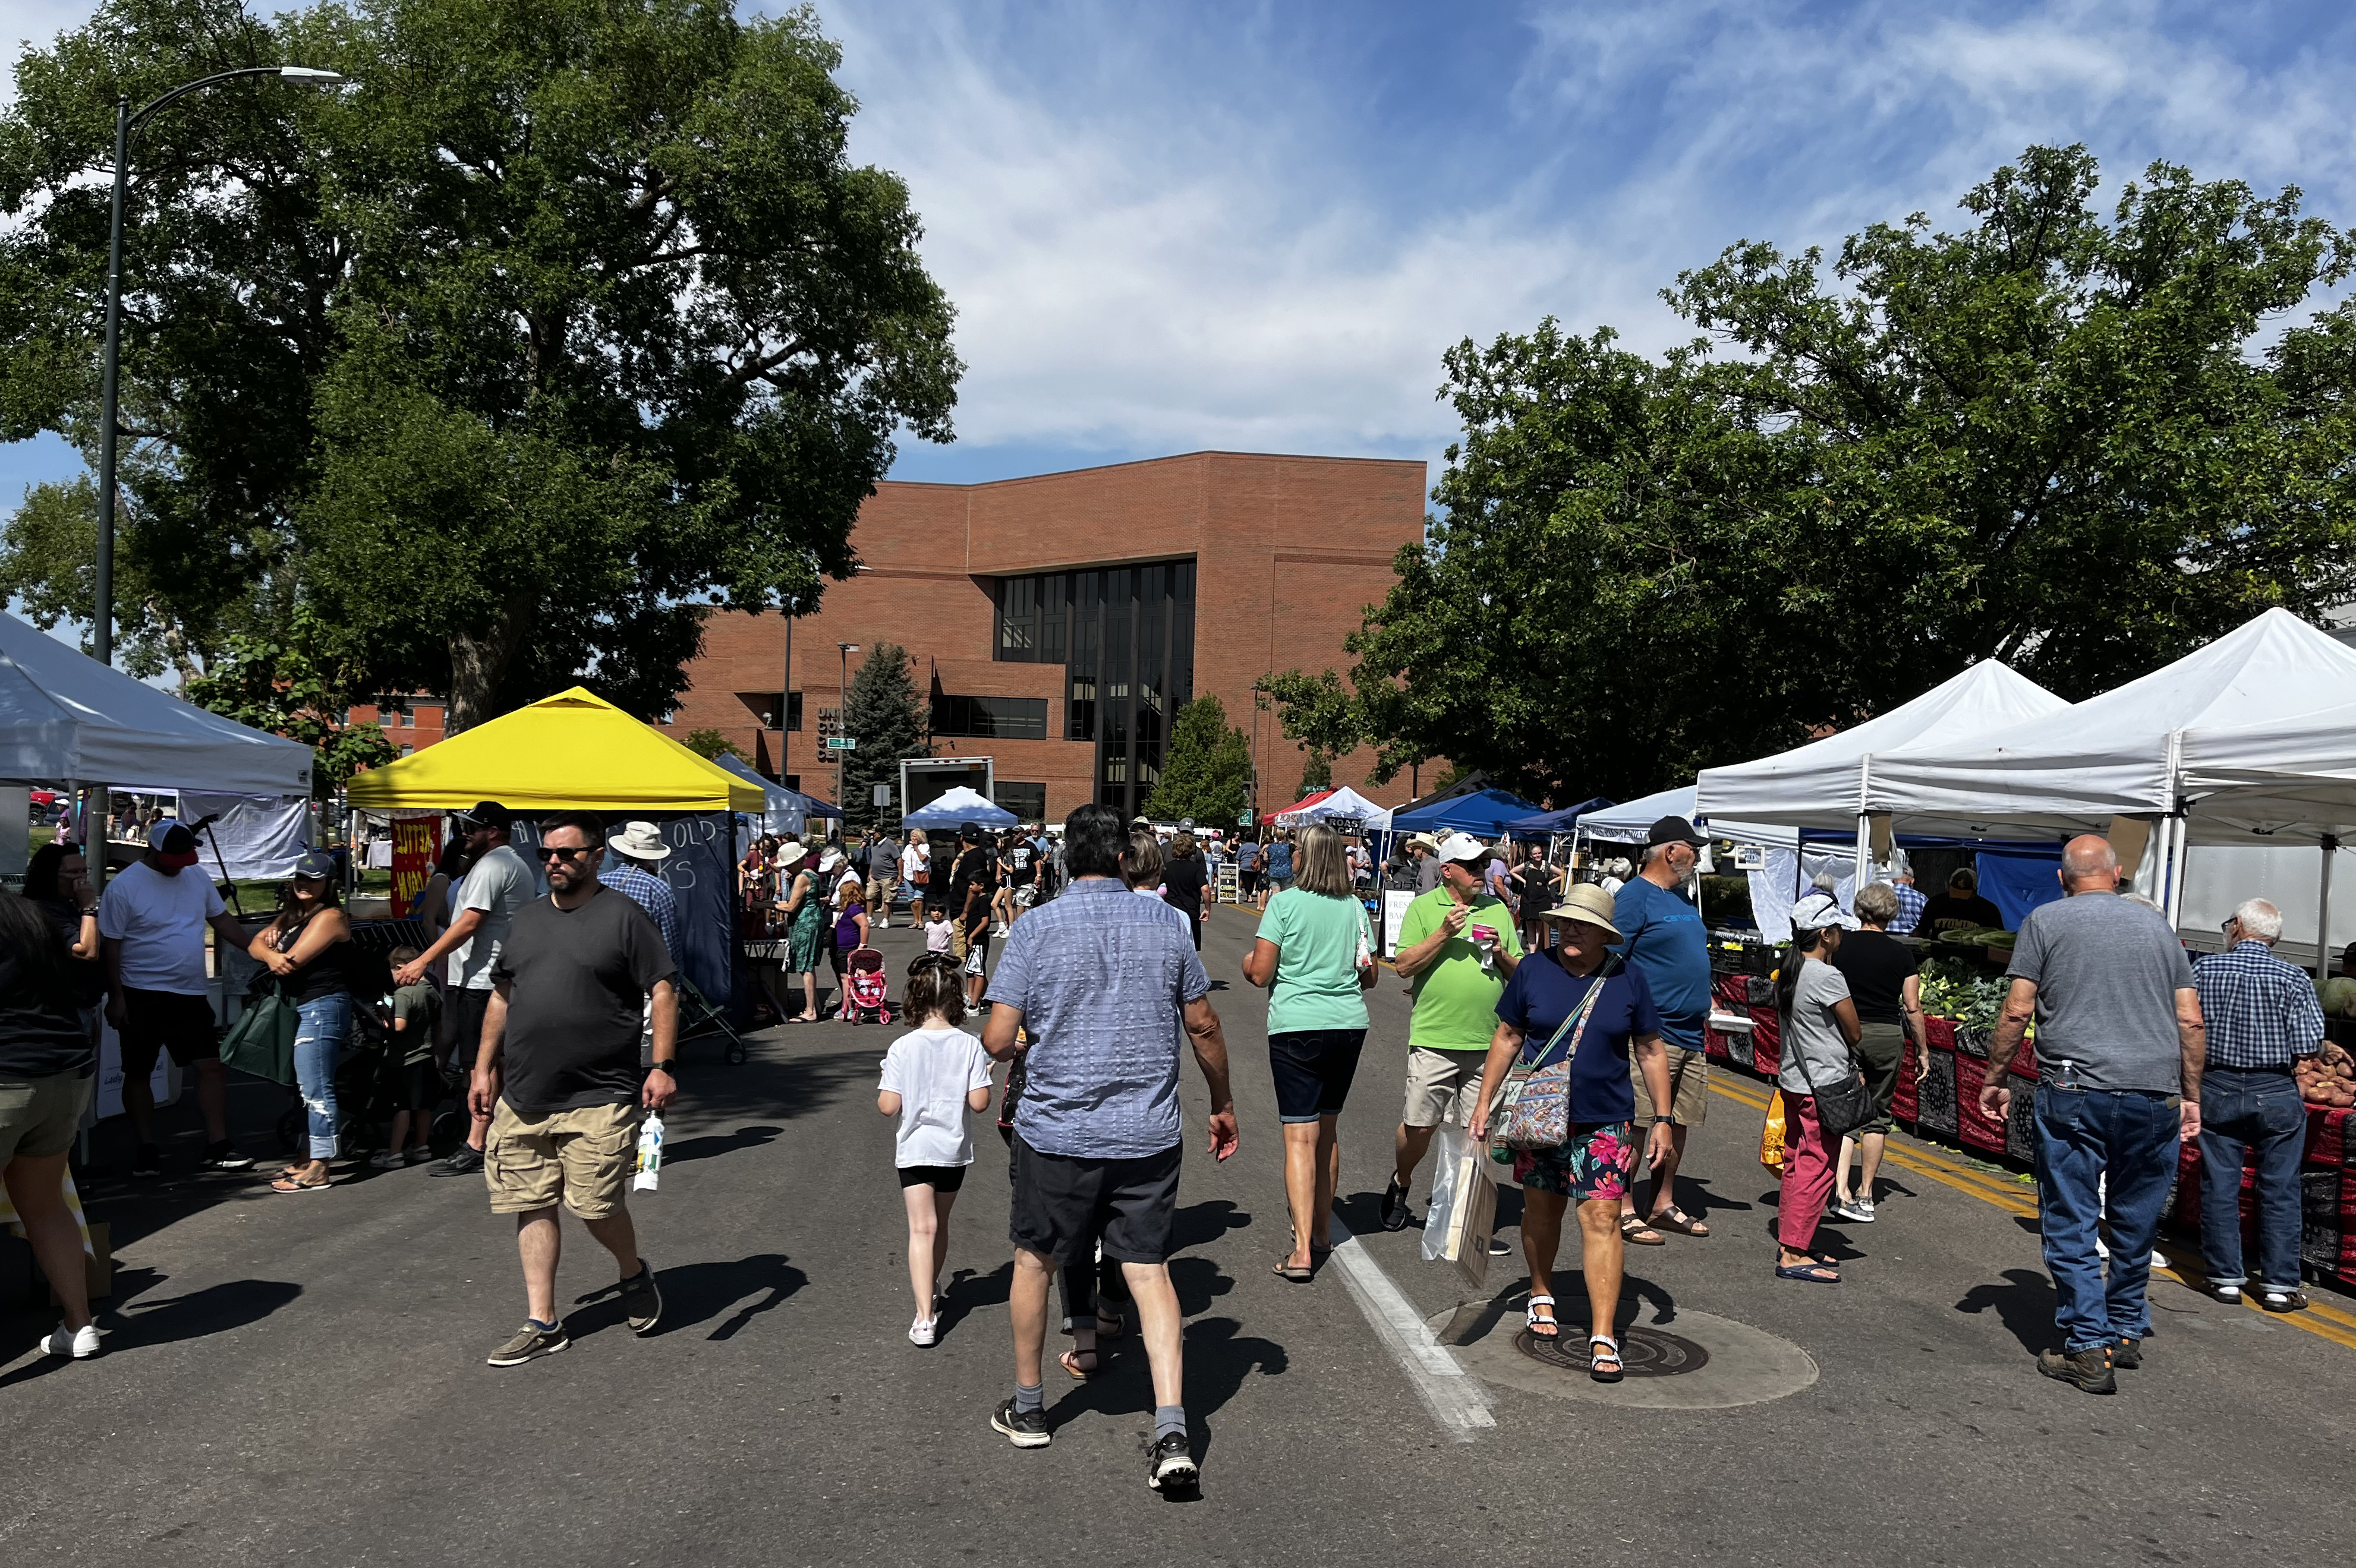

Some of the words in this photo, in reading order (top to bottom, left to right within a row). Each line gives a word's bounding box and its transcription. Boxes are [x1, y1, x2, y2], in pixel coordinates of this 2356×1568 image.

[818, 707, 840, 717] UNI
[818, 721, 839, 731] CO
[1329, 818, 1358, 827] ROAS
